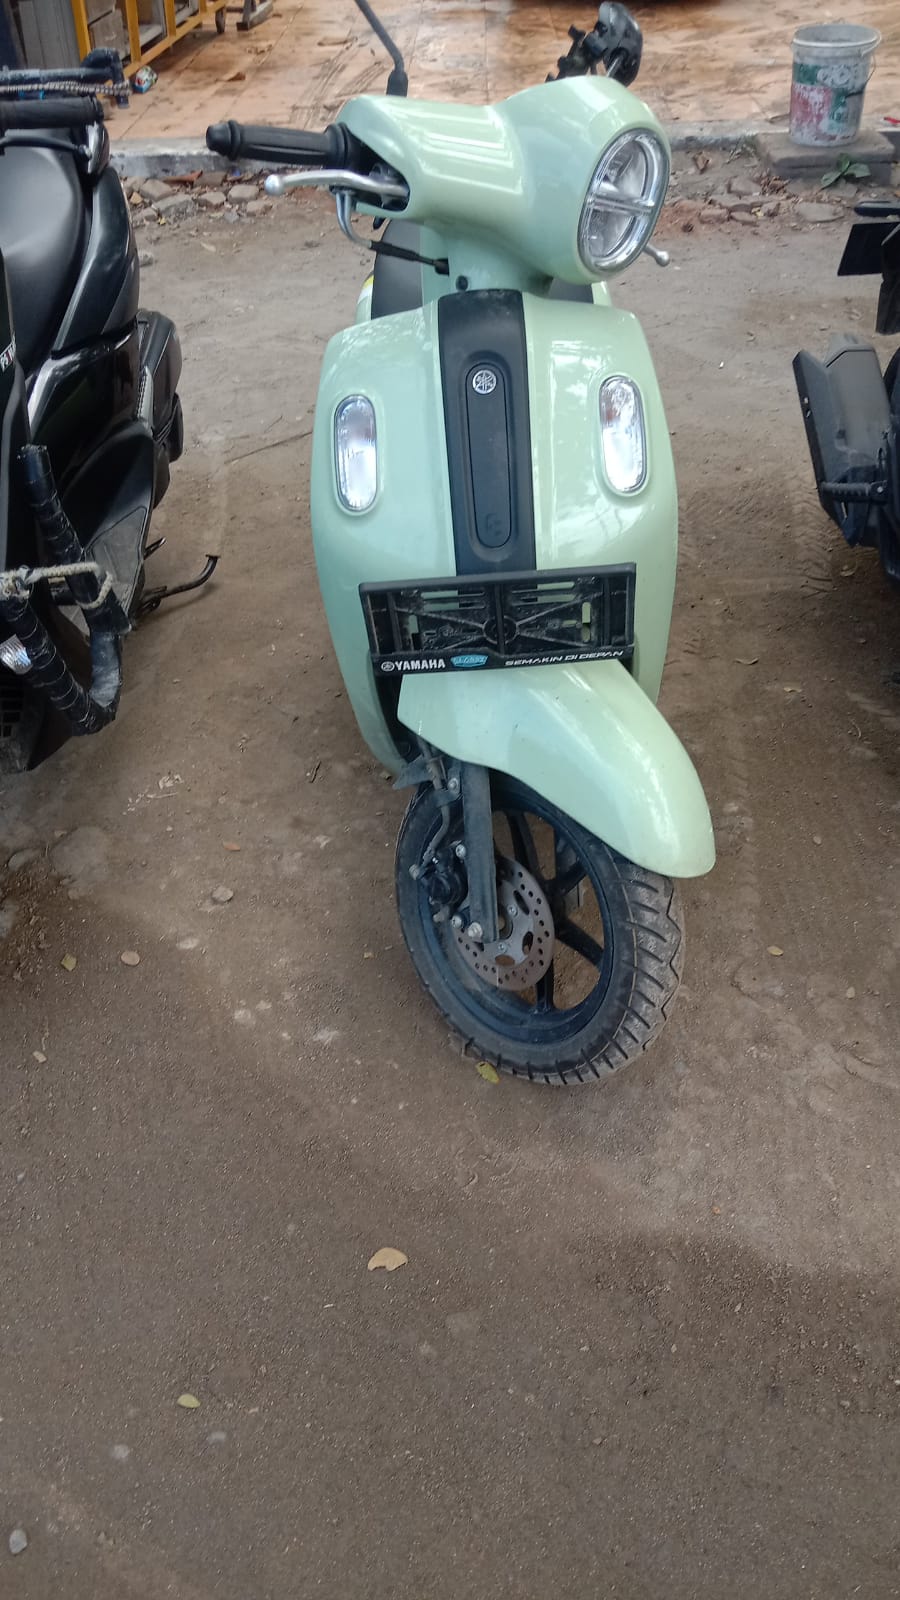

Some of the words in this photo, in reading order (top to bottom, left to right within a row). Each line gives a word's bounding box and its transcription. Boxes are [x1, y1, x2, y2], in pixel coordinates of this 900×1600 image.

[394, 658, 446, 671] YAMAHA
[504, 655, 563, 666] SEMAKIN
[578, 650, 624, 660] DEPAN
